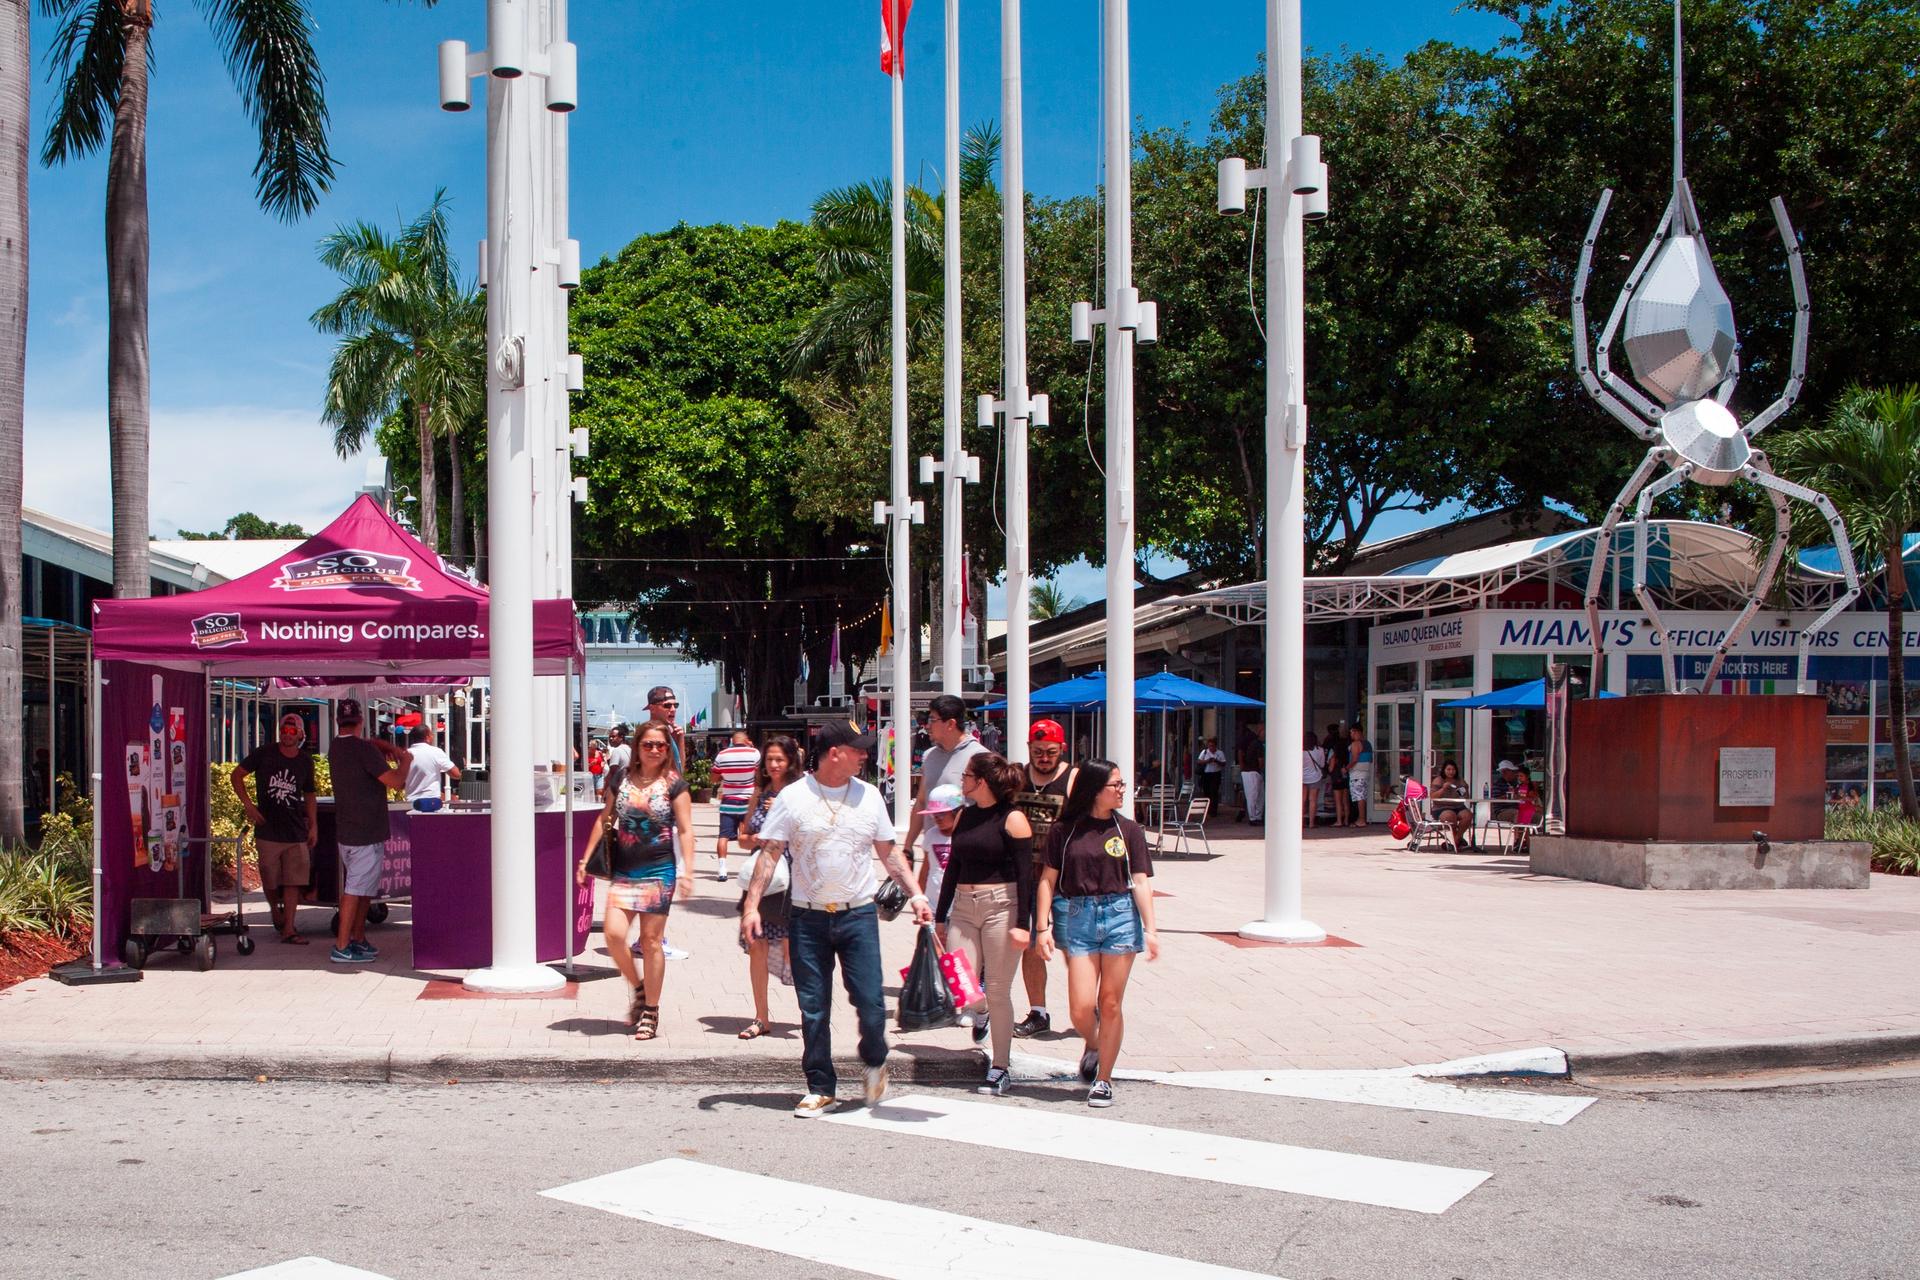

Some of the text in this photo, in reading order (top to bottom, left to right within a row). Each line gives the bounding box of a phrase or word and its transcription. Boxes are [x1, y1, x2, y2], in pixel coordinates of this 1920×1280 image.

[316, 555, 377, 570] SO
[297, 568, 397, 578] DELICIOUS
[301, 576, 343, 586] DAIRY
[205, 616, 229, 629] SO
[199, 625, 238, 635] DELICIOUS
[261, 621, 485, 643] Nothing Compares.
[1383, 618, 1463, 645] ISLAND QUEEN CAFÉ
[1500, 619, 1637, 647] MIAMI'S
[1853, 631, 1920, 647] CENE
[1762, 662, 1788, 674] HERE
[1721, 769, 1774, 780] PROSPERITY
